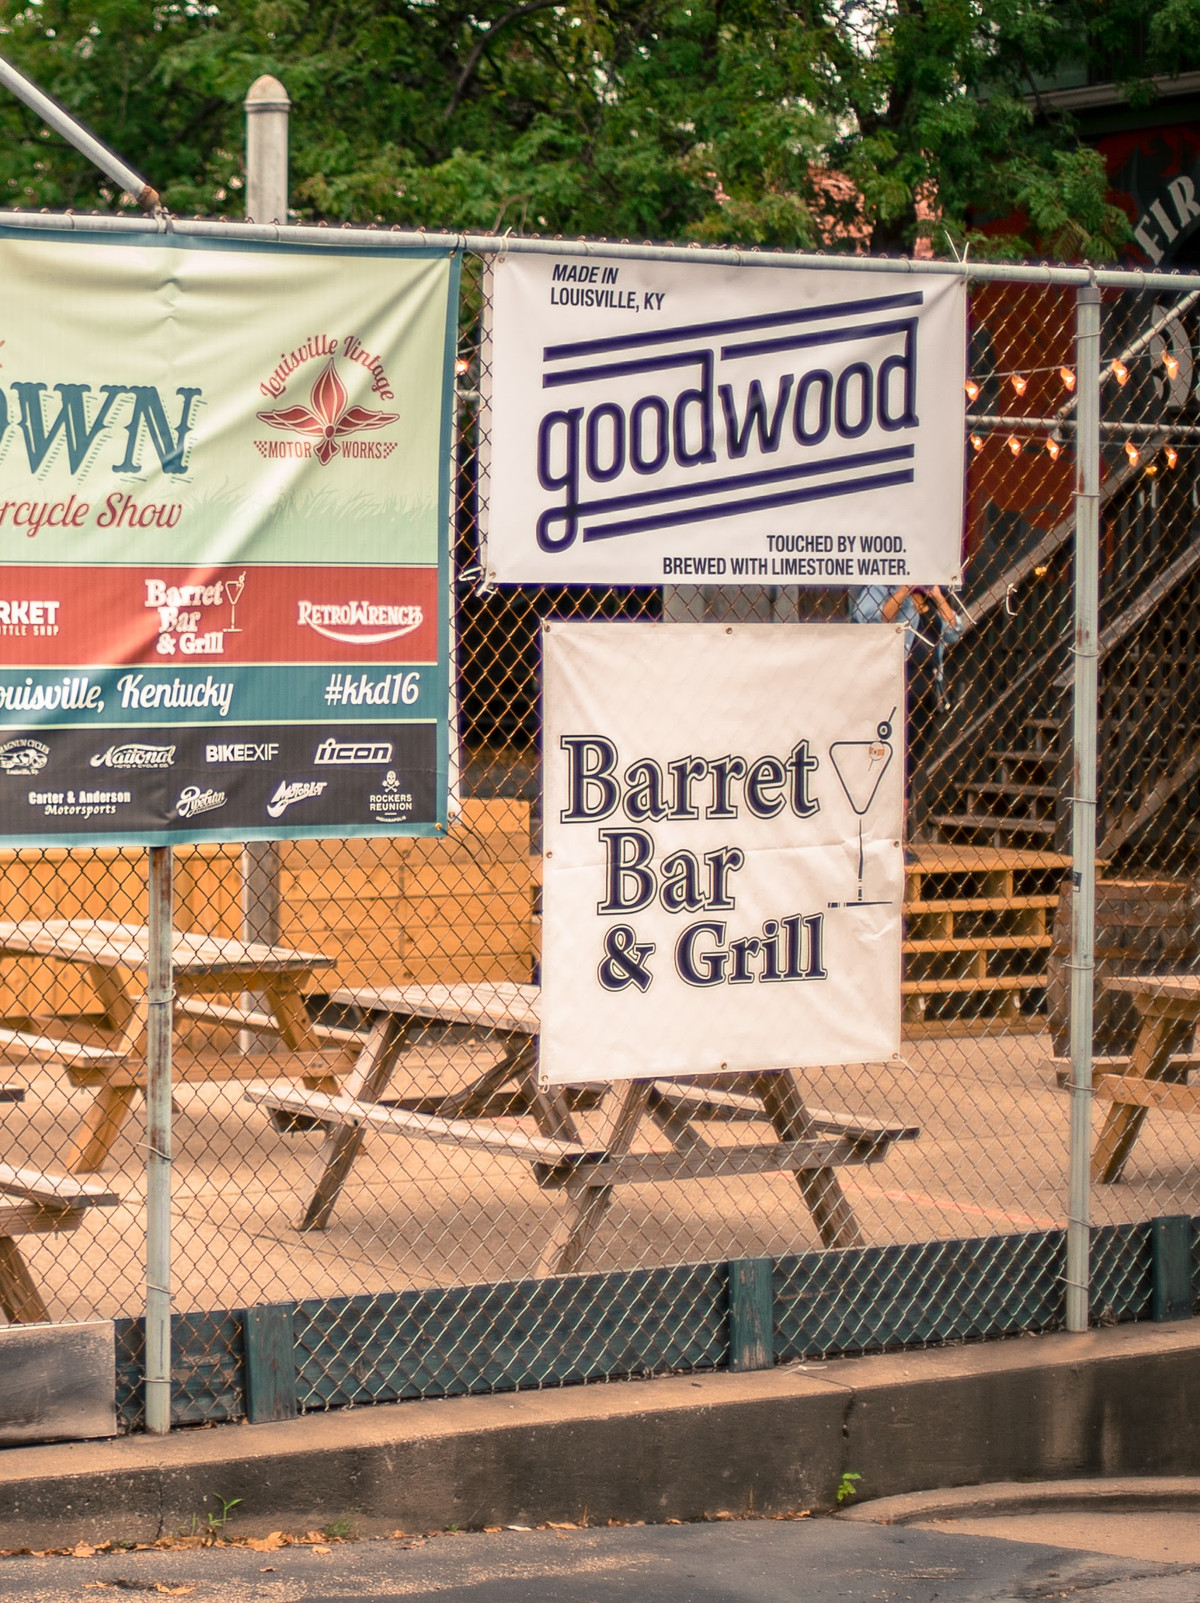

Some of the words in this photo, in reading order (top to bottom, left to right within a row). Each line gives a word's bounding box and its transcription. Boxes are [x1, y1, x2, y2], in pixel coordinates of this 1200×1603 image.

[552, 264, 600, 283] MADE
[601, 267, 619, 284] IN
[551, 287, 640, 312] LOUISVILLE,
[644, 292, 665, 310] KY
[259, 334, 339, 400] Louisville
[344, 335, 395, 400] Vintage
[536, 316, 920, 553] goodwood
[269, 441, 312, 458] MOTOR
[341, 441, 383, 459] WORKS
[96, 492, 184, 529] Show
[766, 534, 833, 552] TOUCHED
[837, 535, 856, 552] BY
[859, 536, 907, 553] WOOD.
[663, 557, 727, 575] BREWED
[730, 558, 768, 575] WITH
[771, 558, 853, 575] LIMESTONE
[857, 559, 910, 576] WATER.
[144, 579, 224, 607] Barret
[33, 625, 59, 636] SHOP
[157, 606, 201, 633] Bar
[156, 633, 176, 655] &
[179, 631, 224, 654] Grill
[117, 674, 234, 716] Kentucky
[324, 672, 420, 706] #kkd16
[205, 743, 280, 763] BIKEEXIF
[560, 734, 821, 824] Barret
[28, 791, 65, 805] Carter
[66, 791, 76, 804] &
[79, 790, 131, 804] Anderson
[369, 794, 413, 803] ROCKERS
[369, 803, 413, 811] REUNION
[44, 804, 117, 820] Motorsports
[597, 827, 745, 915] Bar
[597, 924, 656, 993] &
[674, 912, 828, 988] Grill
